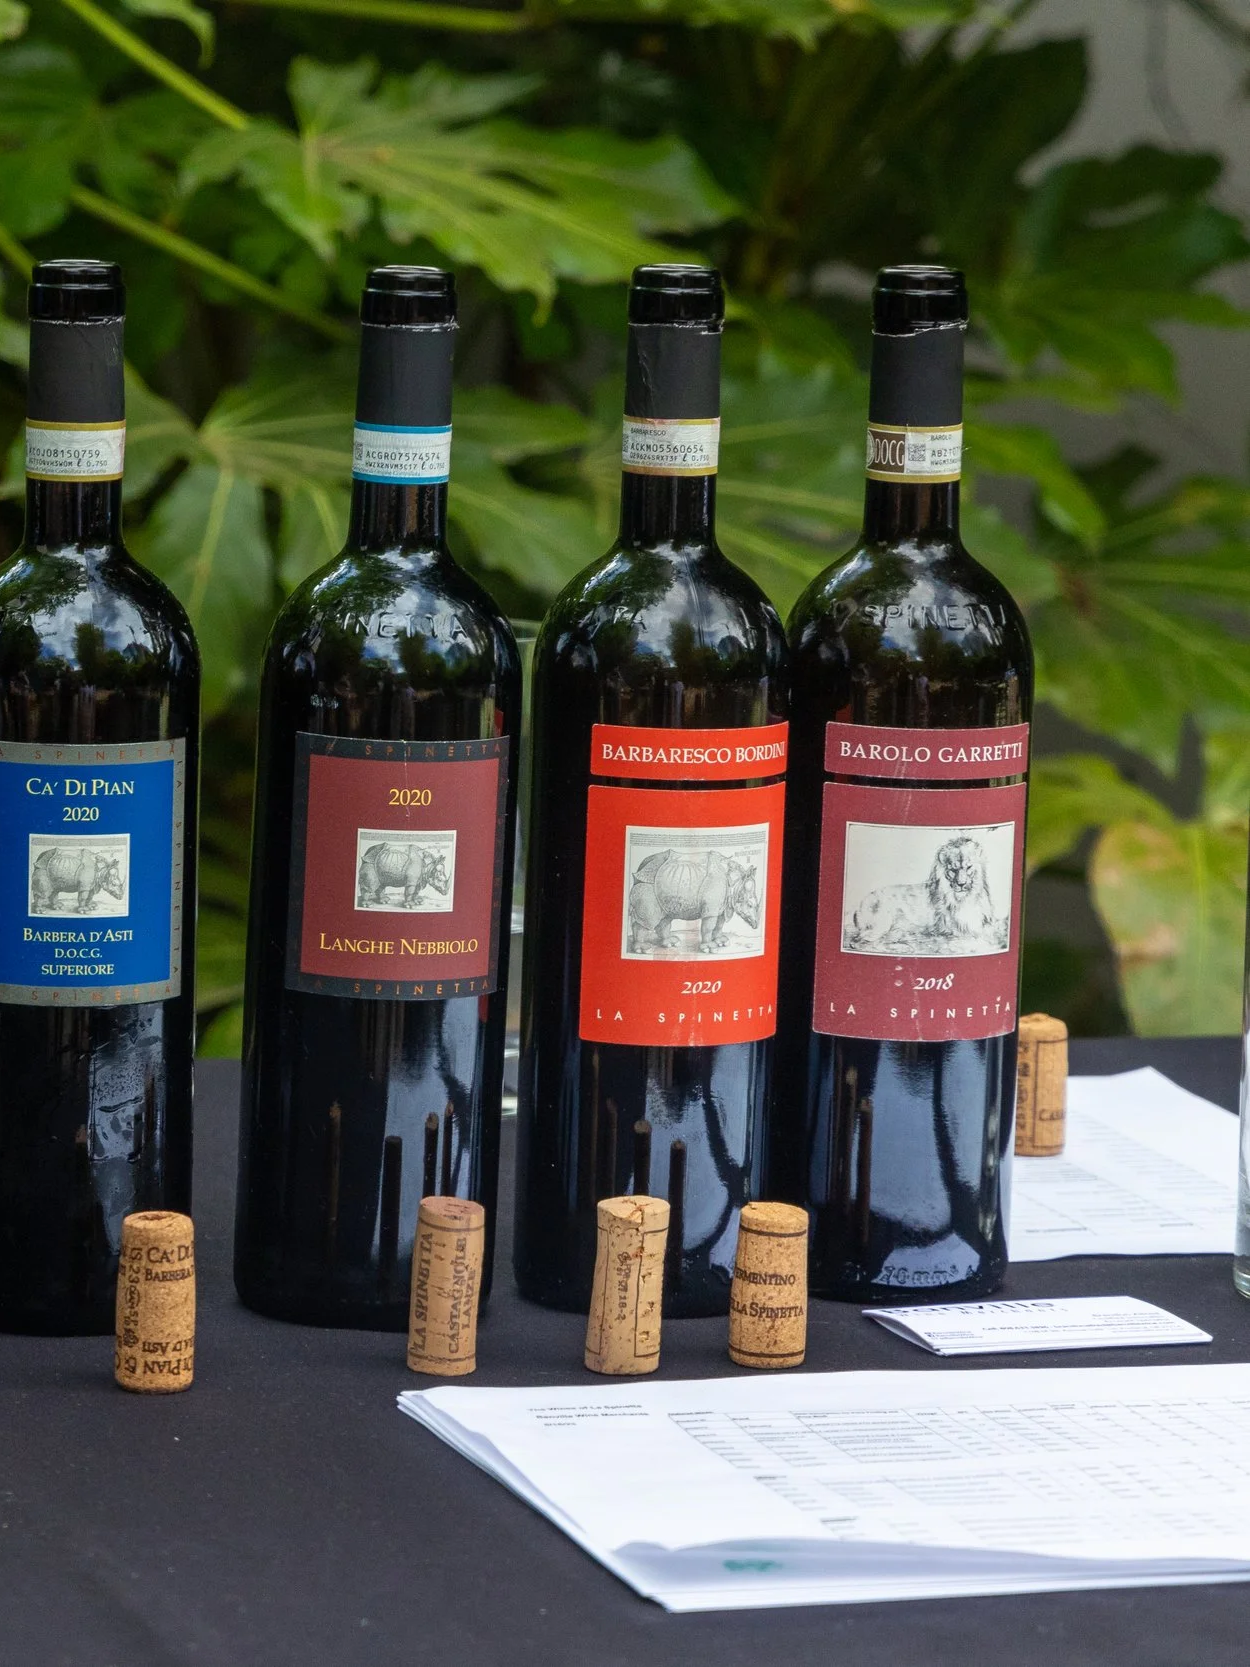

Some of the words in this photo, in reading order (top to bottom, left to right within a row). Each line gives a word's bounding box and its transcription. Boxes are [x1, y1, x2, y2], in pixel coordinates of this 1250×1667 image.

[874, 438, 905, 466] DOCG
[602, 743, 731, 764] BARBARESCO
[735, 741, 785, 763] BORDINI
[840, 741, 931, 762] BAROLO
[938, 742, 1022, 763] GARRETTI
[388, 788, 432, 806] 2020
[62, 807, 100, 822] 2020
[54, 948, 103, 959] D.O.C.G.
[41, 964, 114, 976] SUPERIORE
[681, 980, 722, 994] 2020
[913, 973, 955, 990] 2018
[597, 1009, 623, 1021] LA
[658, 1004, 772, 1023] SPINETTA
[830, 1002, 856, 1015] LA
[890, 1001, 1010, 1018] SPINETTA
[415, 1232, 433, 1322] SPINETTA
[750, 1302, 804, 1320] SPINETTA
[413, 1325, 426, 1351] LA
